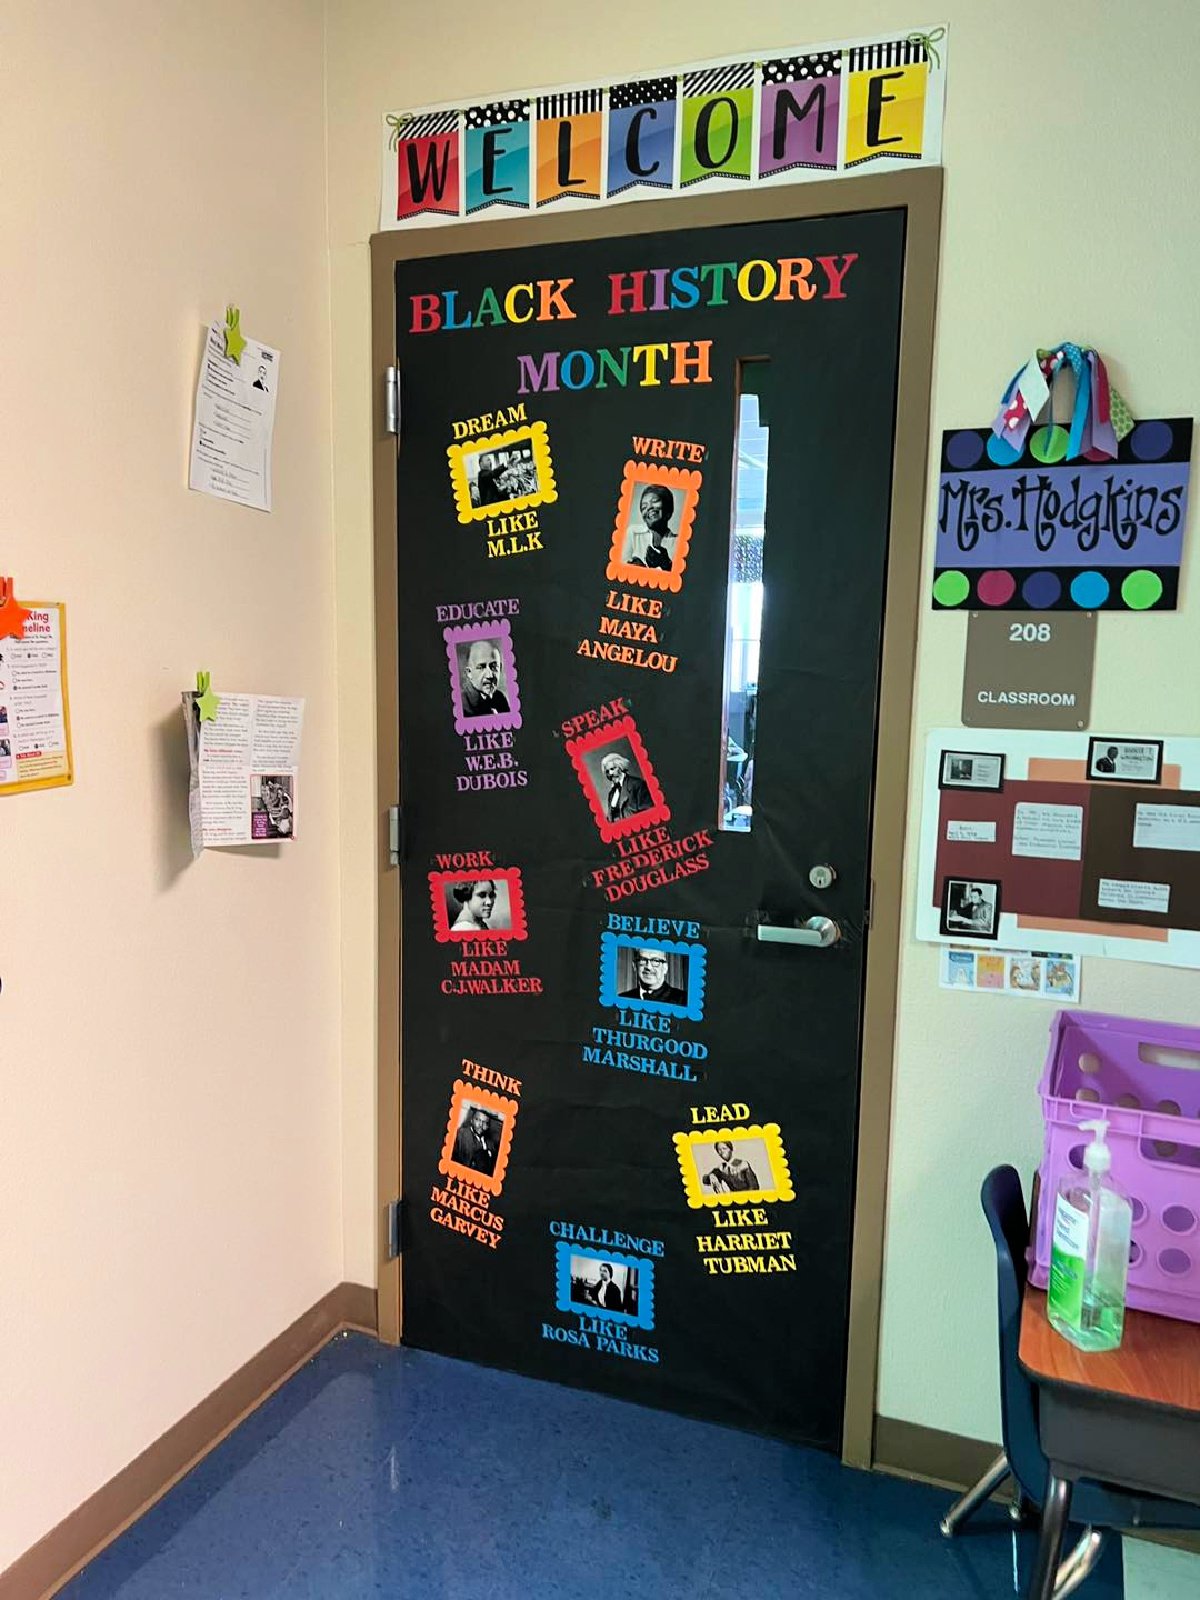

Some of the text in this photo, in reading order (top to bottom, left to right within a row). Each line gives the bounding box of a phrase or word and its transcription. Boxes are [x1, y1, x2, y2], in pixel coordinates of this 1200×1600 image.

[404, 71, 904, 203] WELCOME
[410, 253, 859, 334] BLACK HISTORY
[518, 340, 713, 394] MONTH
[452, 403, 527, 439] DREAM
[632, 436, 704, 463] WRITE
[487, 511, 538, 537] LIKE
[939, 474, 1183, 551] Mrs. Hodgkins
[488, 532, 544, 558] M.L.K
[436, 599, 520, 622] EDUCATE
[606, 590, 663, 619] LIKE
[599, 617, 657, 643] MAYA
[1009, 622, 1051, 642] 208
[577, 639, 678, 673] ANGELOU
[978, 691, 1075, 706] CLASSROOM
[562, 698, 629, 738] SPEAK
[464, 732, 514, 751] LIKE
[457, 771, 528, 791] DUBOIS
[617, 827, 670, 857] LIKE
[436, 851, 494, 869] WORK
[592, 830, 713, 888] FREDERICK
[607, 854, 709, 902] DOUGLASS
[608, 913, 699, 938] BELIEVE
[462, 941, 508, 957] LIKE
[452, 960, 520, 977] MADAM
[618, 1010, 671, 1034] LIKE
[593, 1027, 708, 1060] THURGOOD
[462, 1058, 522, 1097] THINK
[582, 1047, 698, 1082] MARSHALL
[691, 1103, 750, 1124] LEAD
[446, 1177, 490, 1210] LIKE
[430, 1186, 504, 1232] MARCUS
[712, 1208, 767, 1228] LIKE
[430, 1208, 501, 1250] GARVEY
[550, 1220, 664, 1257] CHALLENGE
[697, 1232, 792, 1253] HARRIET
[704, 1254, 796, 1274] TUBMAN
[579, 1316, 628, 1341] LIKE
[542, 1323, 659, 1364] ROSA PARKS
